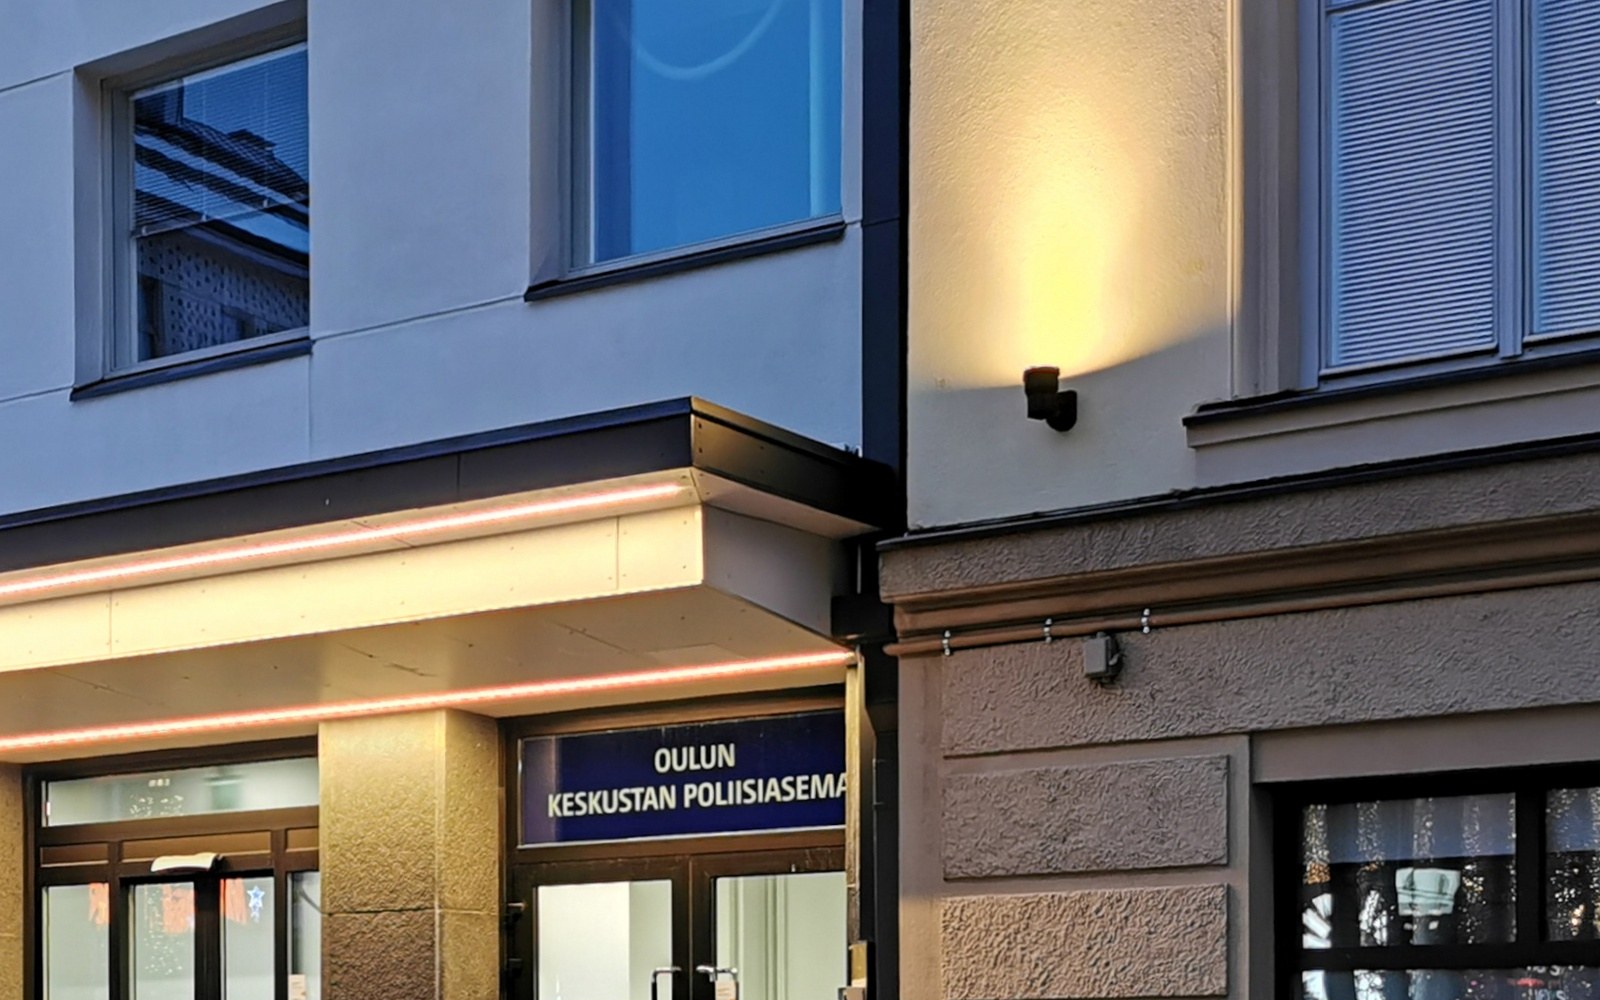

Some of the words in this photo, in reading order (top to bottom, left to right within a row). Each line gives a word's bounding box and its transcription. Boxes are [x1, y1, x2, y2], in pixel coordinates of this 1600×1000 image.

[654, 743, 736, 773] OULUN
[547, 785, 677, 818] KESKUSTAN
[683, 772, 847, 809] POLIISIASEMA
